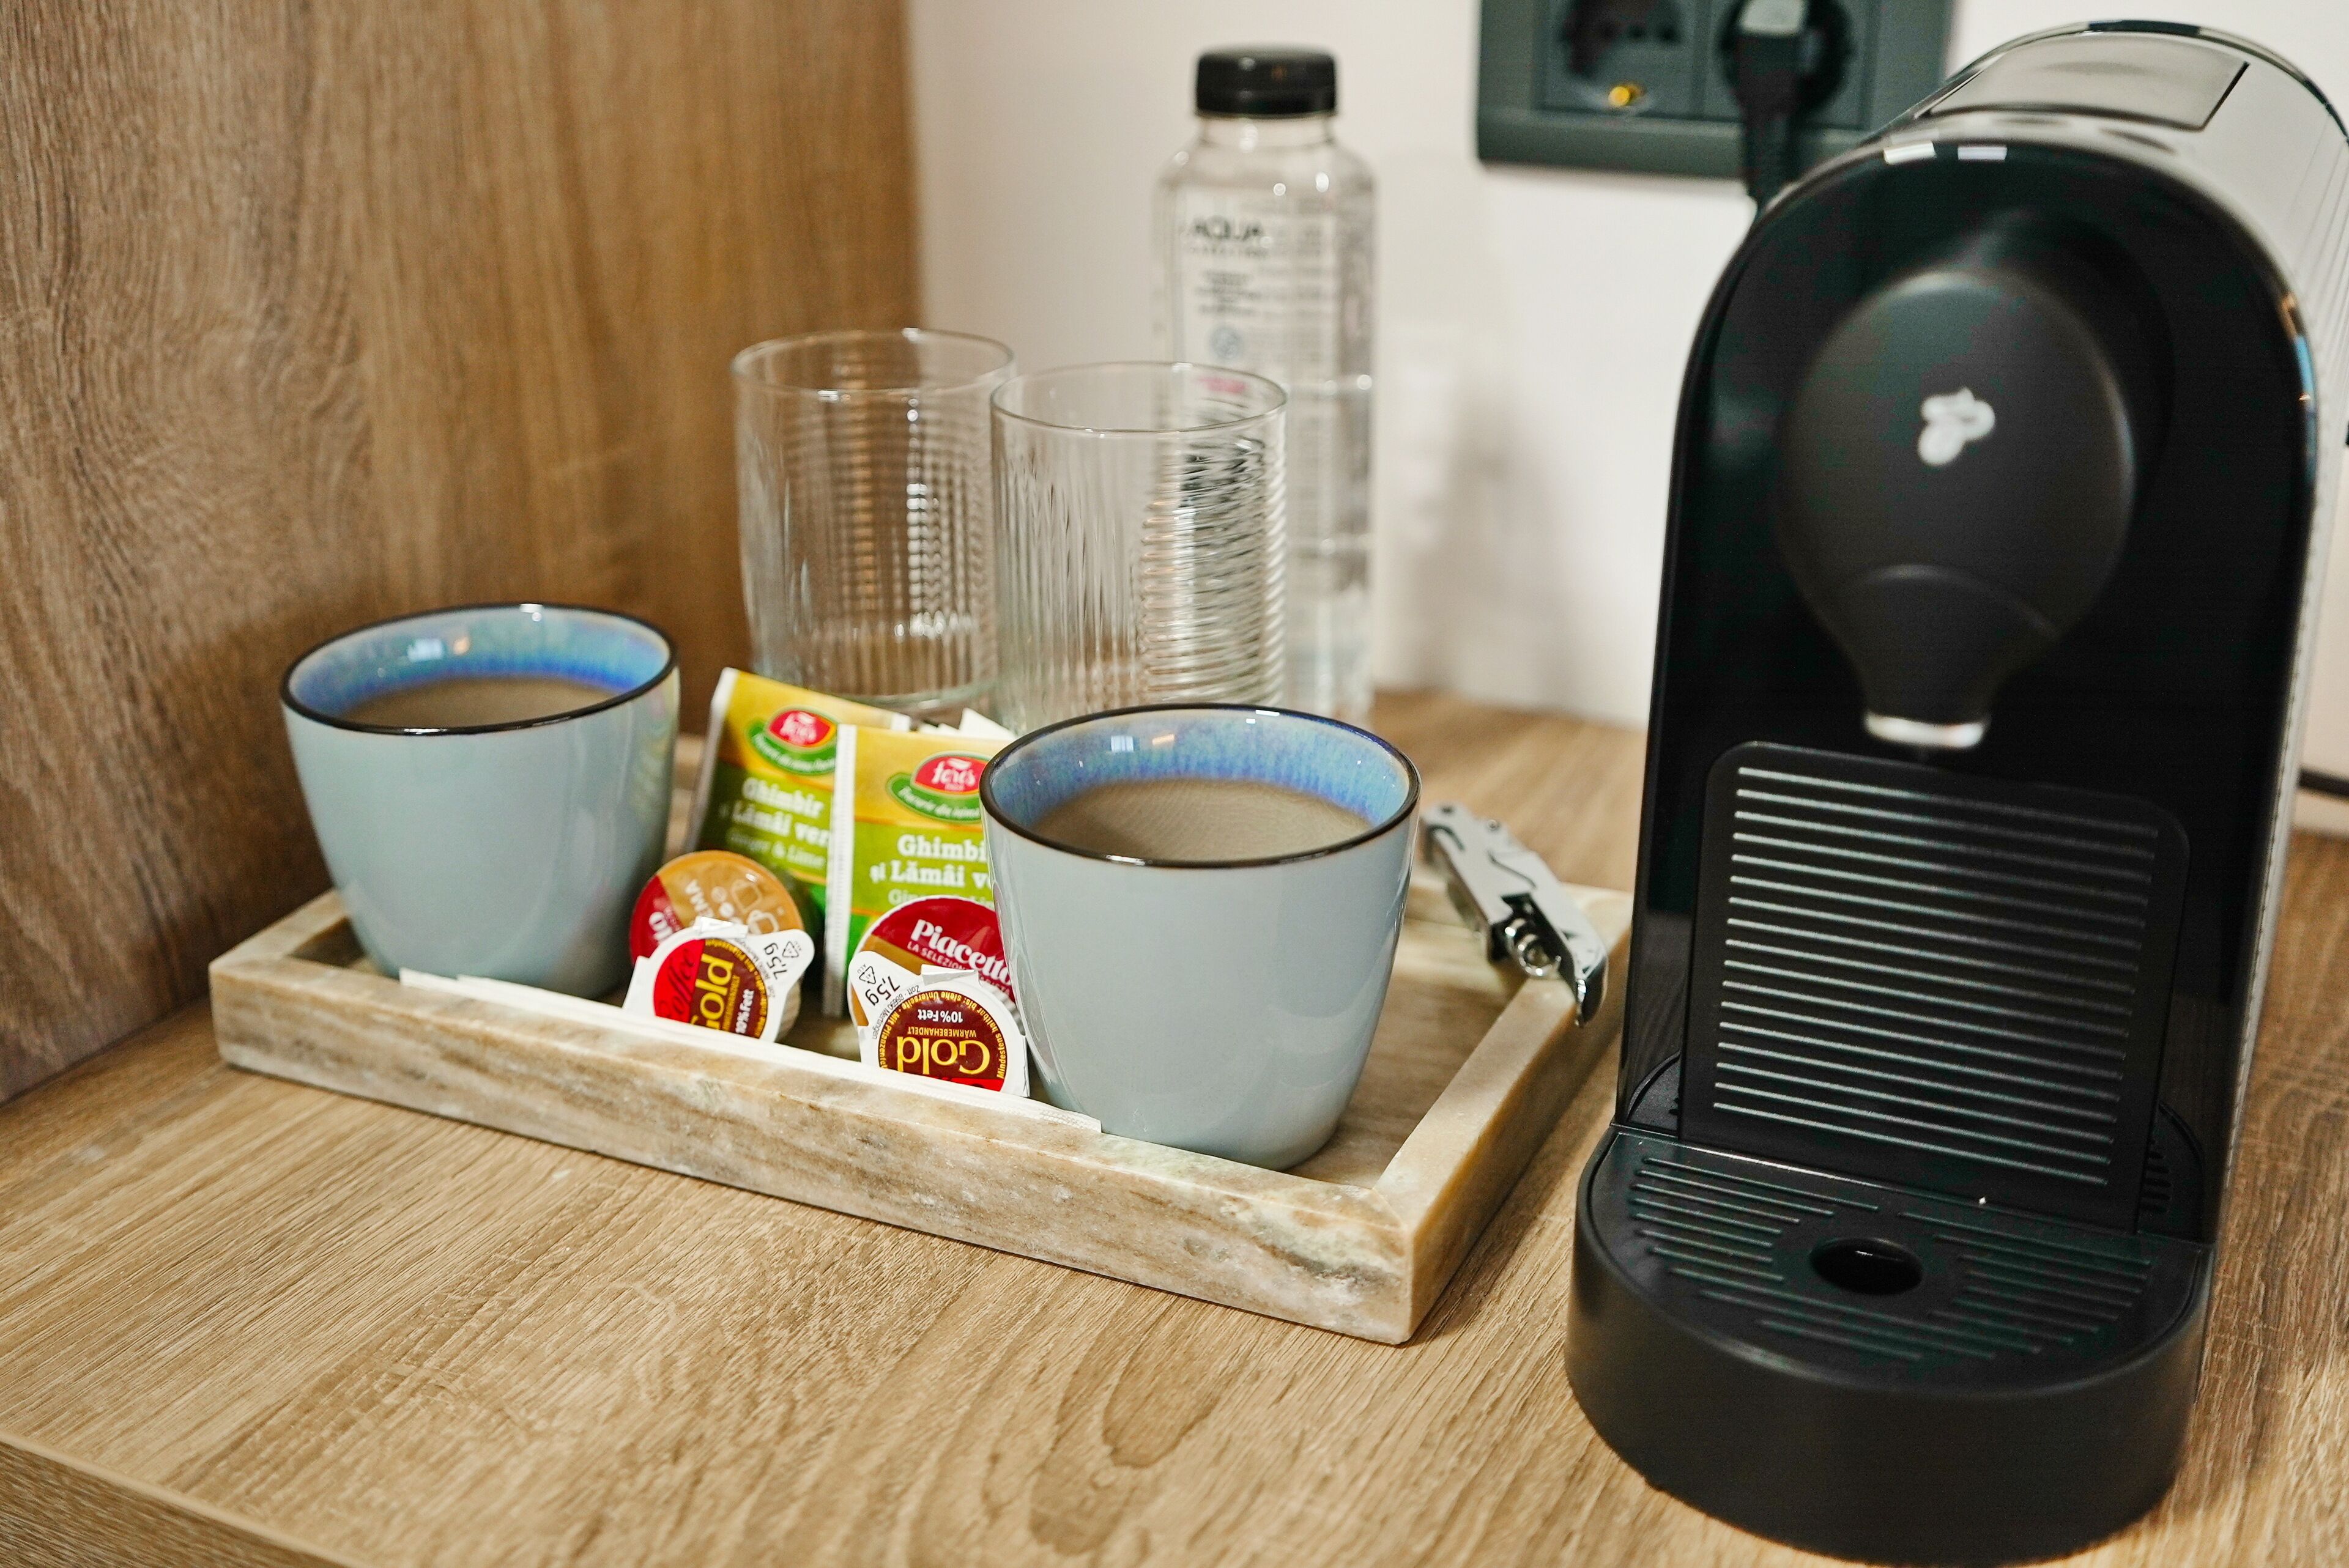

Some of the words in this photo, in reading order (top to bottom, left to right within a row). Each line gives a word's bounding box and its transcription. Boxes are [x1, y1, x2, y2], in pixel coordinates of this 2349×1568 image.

[743, 777, 825, 818] Ghimbir
[795, 822, 830, 848] ver
[897, 834, 987, 862] Ghimbi
[907, 941, 920, 953] LA
[901, 991, 940, 1010] Unterseite
[941, 991, 962, 1002] siehe
[888, 1011, 900, 1025] Mit
[917, 1009, 939, 1022] Fett
[940, 1010, 963, 1023] 10%
[976, 1007, 999, 1033] haltbar
[907, 1026, 977, 1039] WÄRMEBEHANDELT
[897, 1035, 990, 1075] Gold
[995, 1032, 1006, 1079] Mindestens
